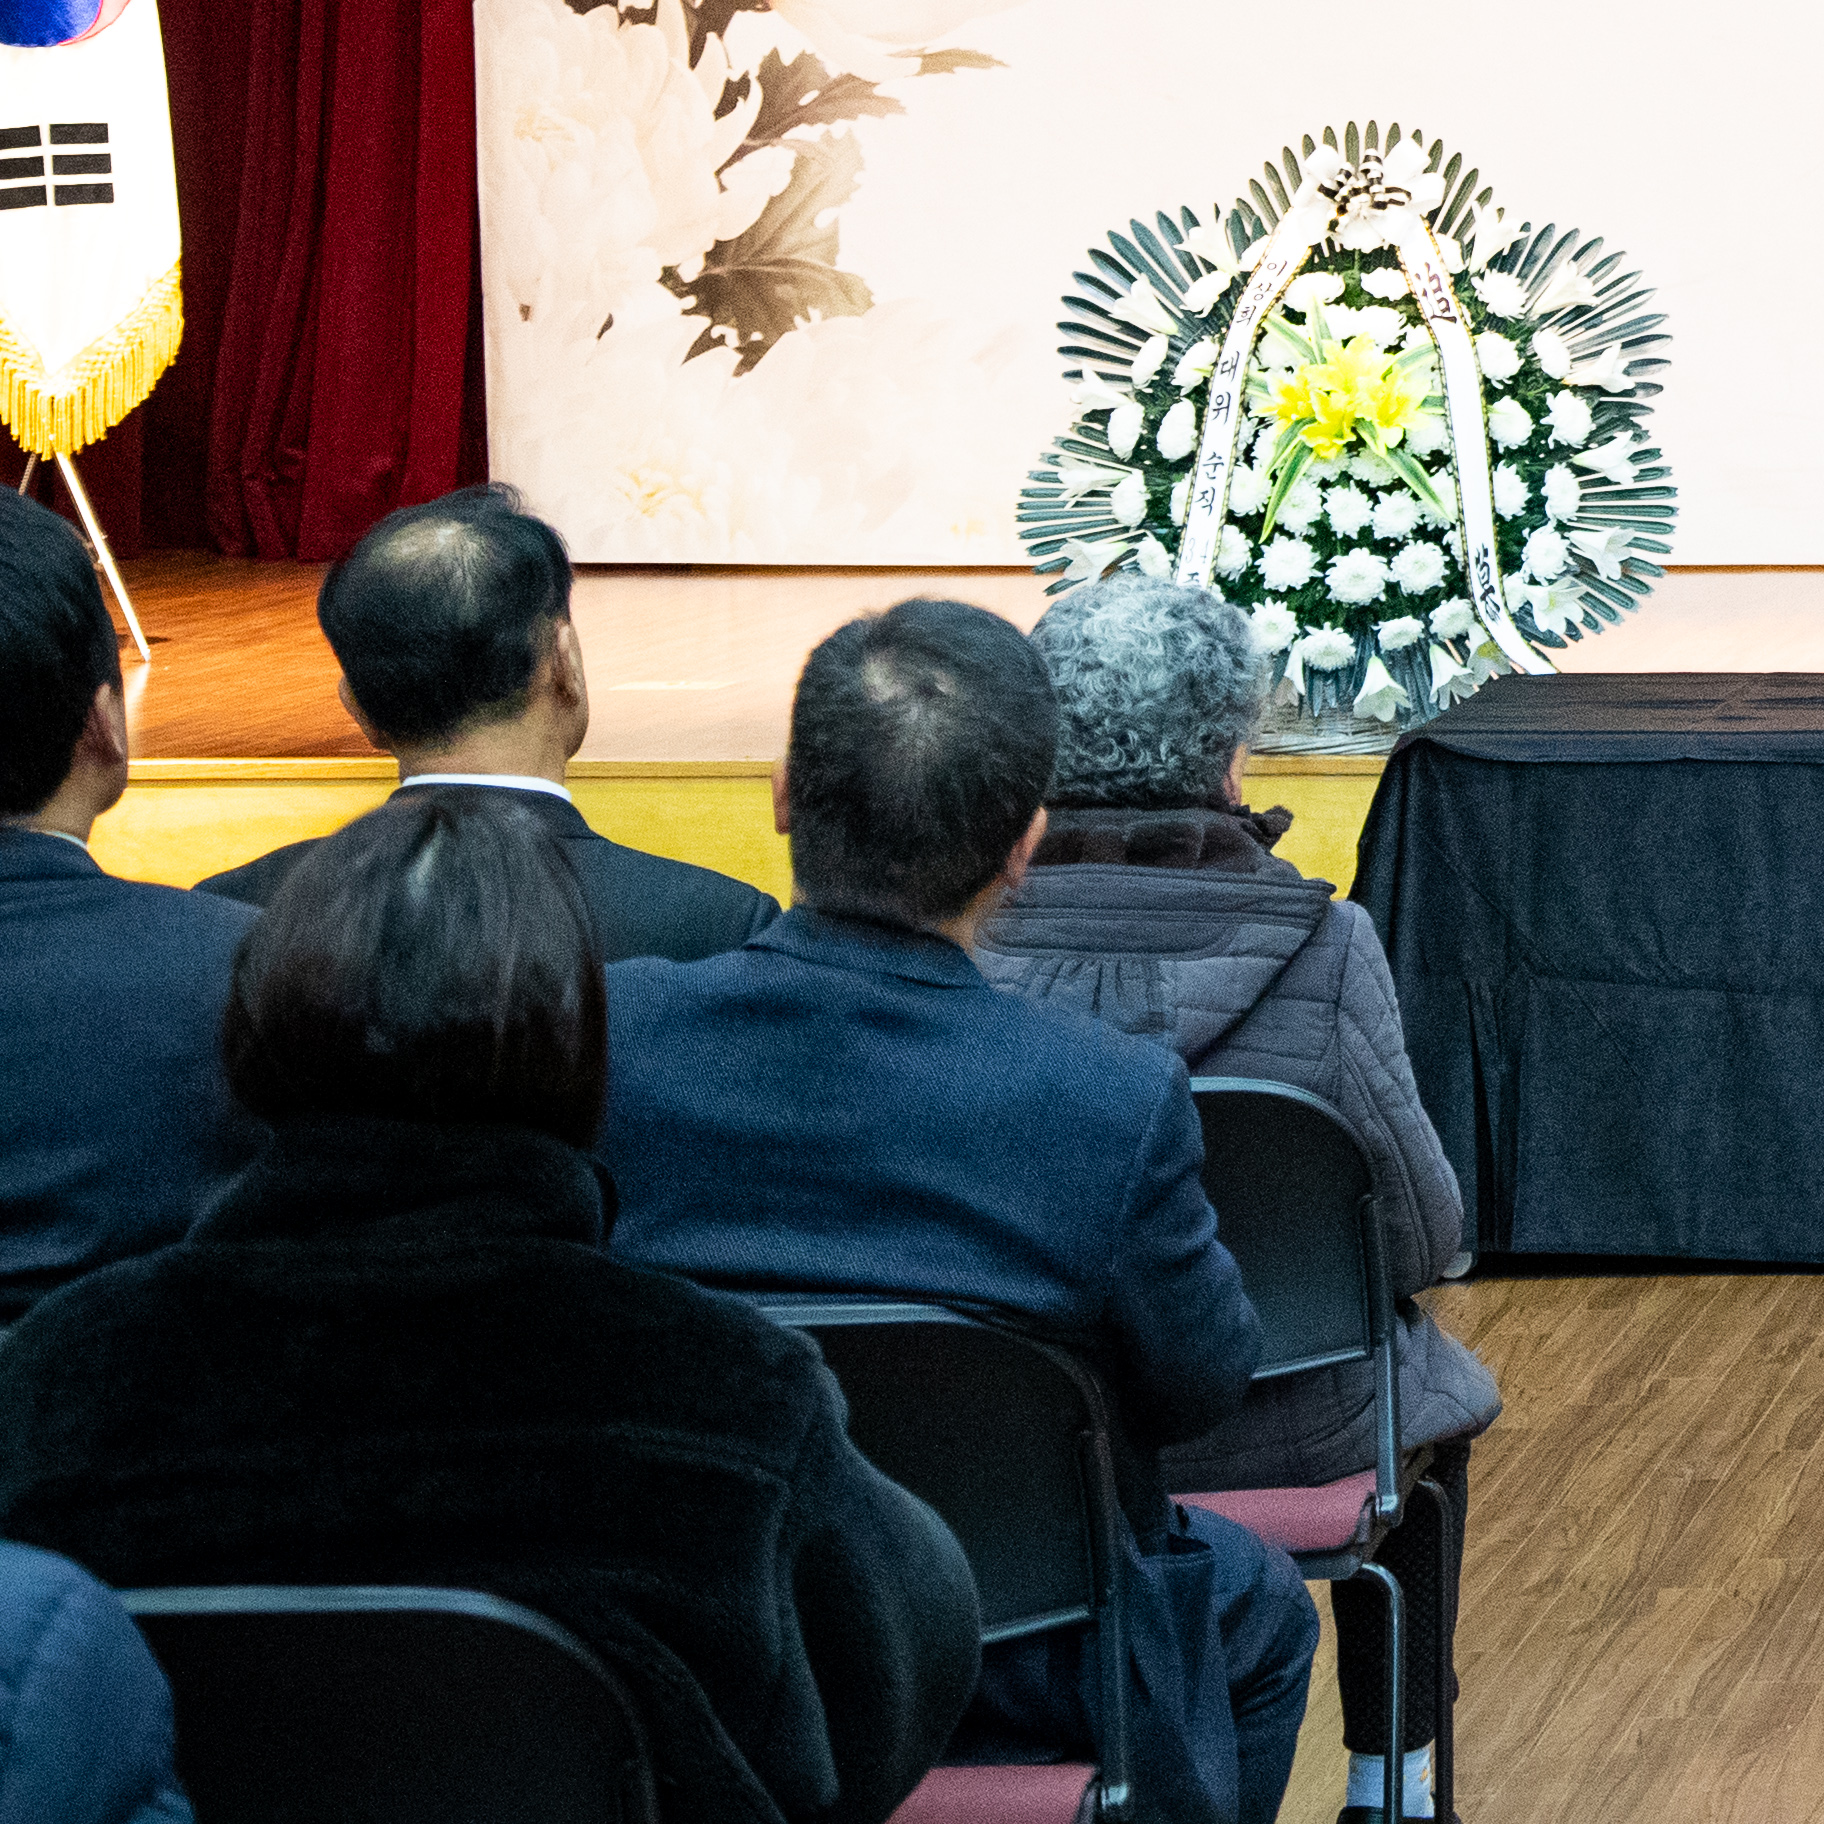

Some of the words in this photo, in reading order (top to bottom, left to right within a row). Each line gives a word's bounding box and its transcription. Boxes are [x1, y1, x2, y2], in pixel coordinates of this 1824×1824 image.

[1235, 259, 1289, 327] 이상희
[1209, 350, 1241, 425] 대위
[1194, 450, 1226, 517] 순직
